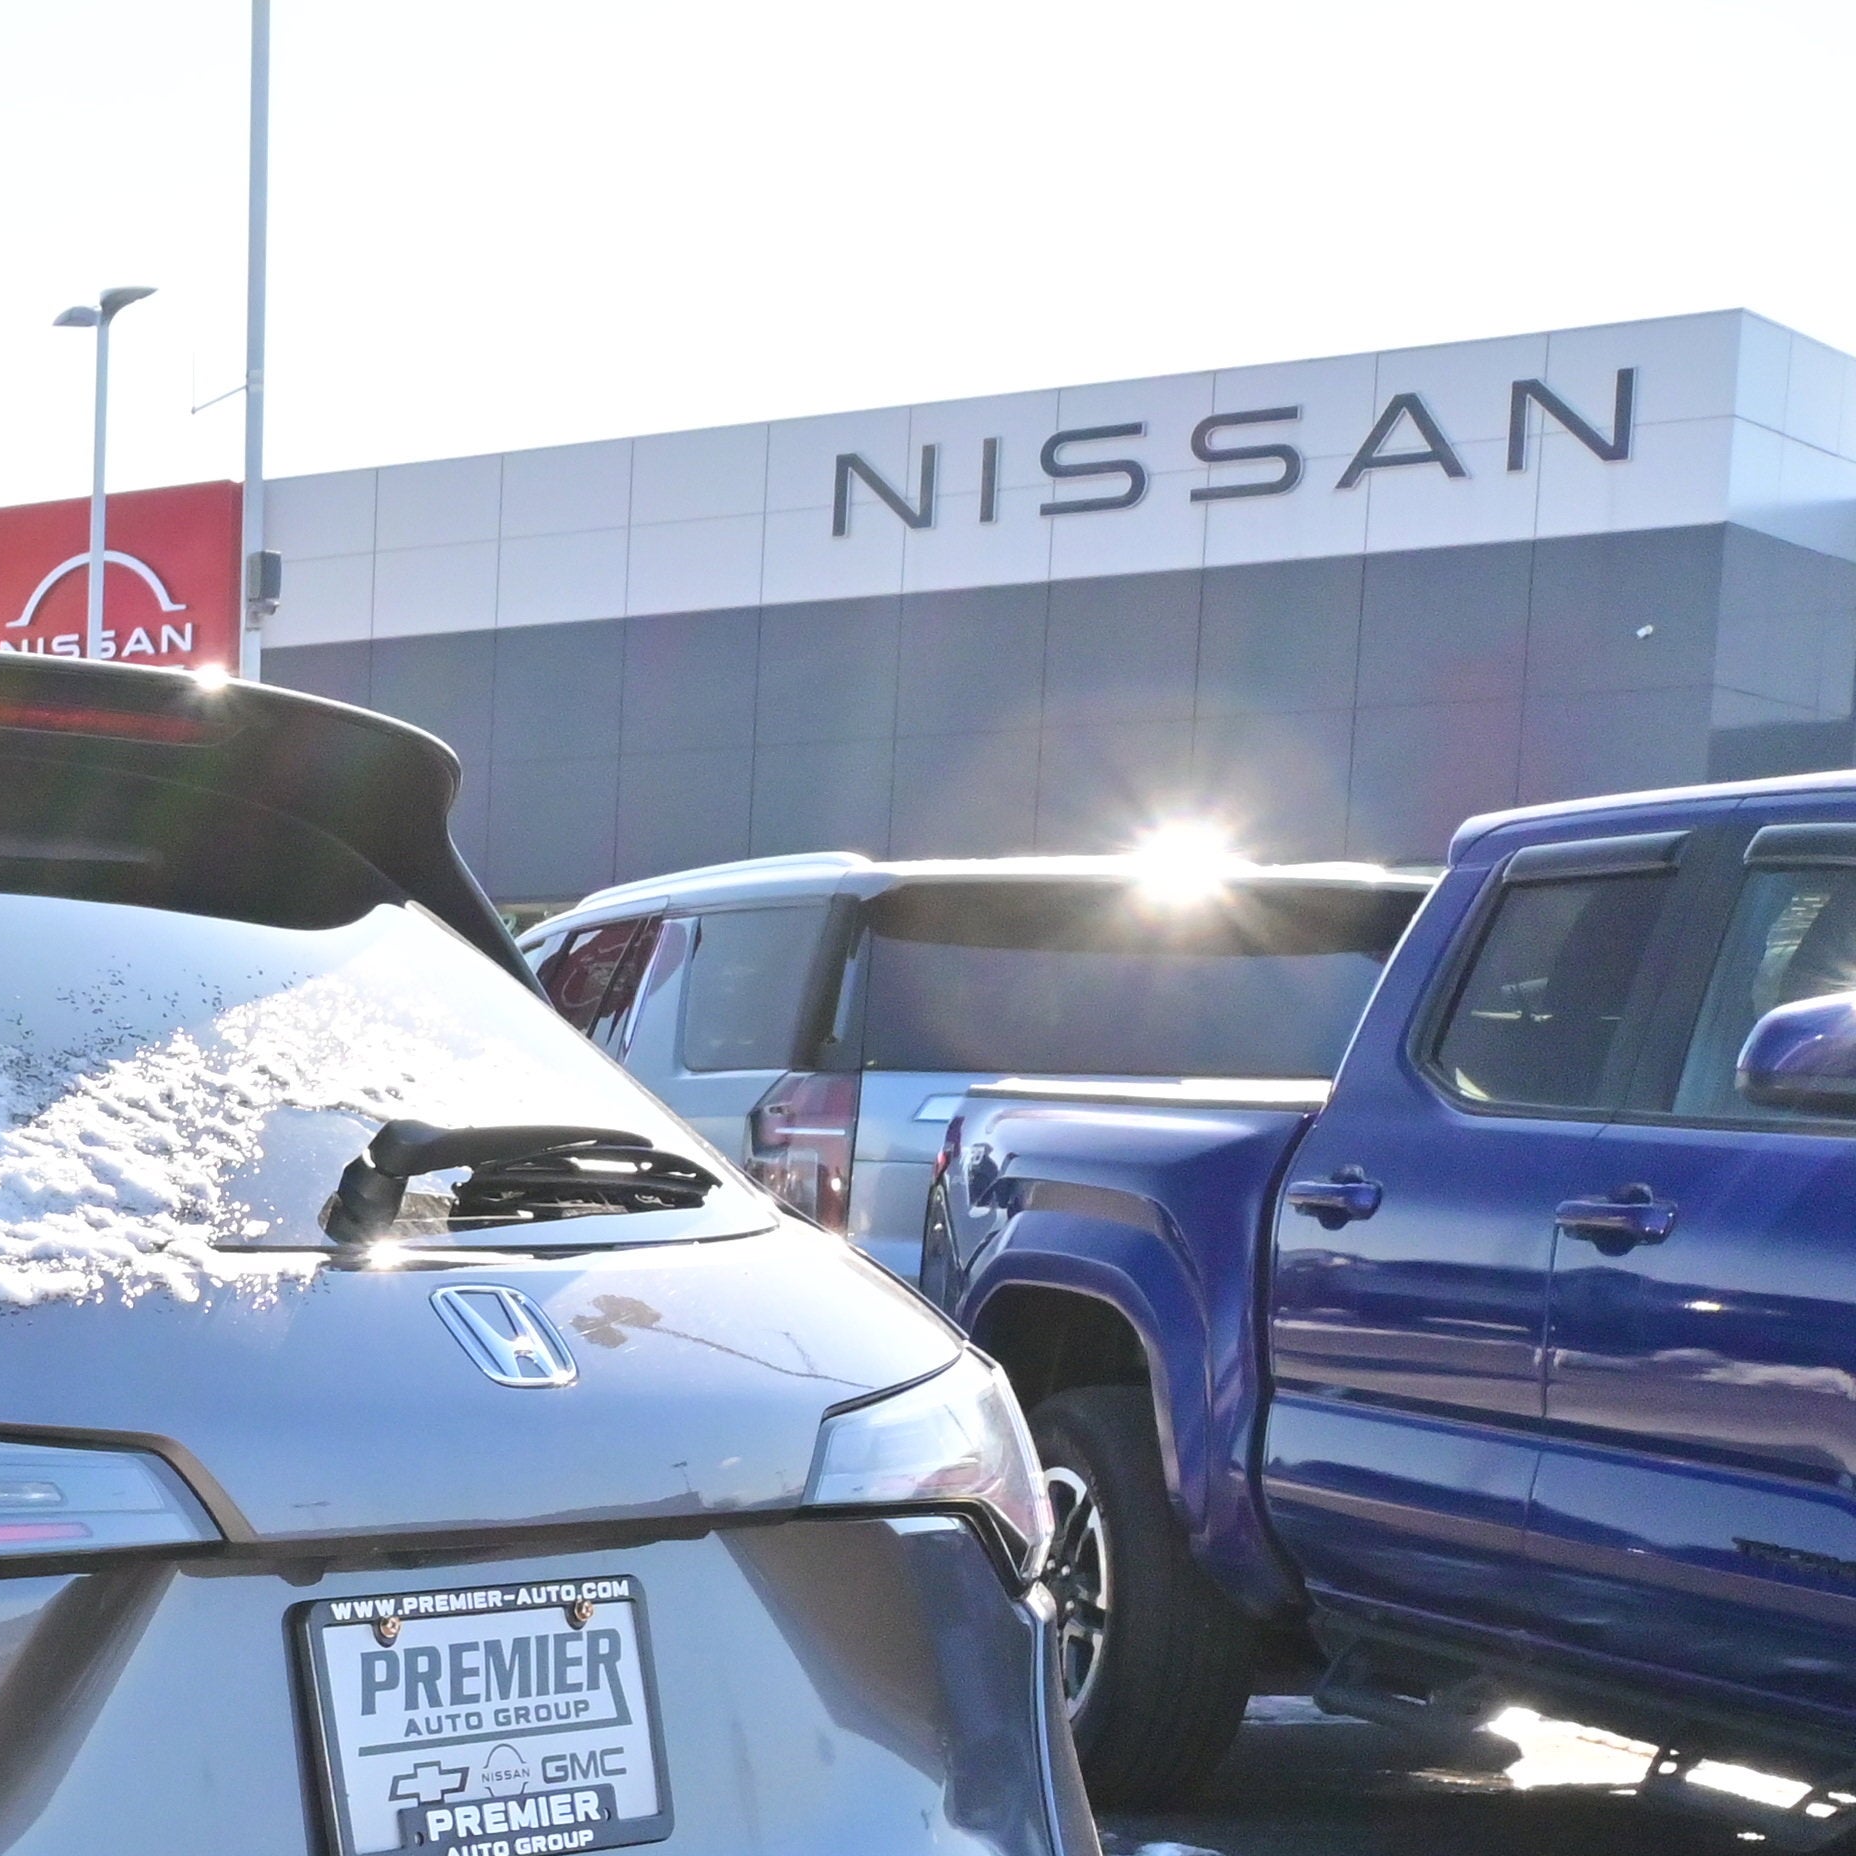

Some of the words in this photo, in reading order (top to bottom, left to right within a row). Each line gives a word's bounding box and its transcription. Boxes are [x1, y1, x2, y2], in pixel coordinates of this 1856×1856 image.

[831, 366, 1636, 537] NISSAN
[331, 1580, 630, 1621] WWW.PREMIER-AUTO.COM
[360, 1627, 630, 1719] PREMIER
[403, 1708, 484, 1738] AUTO
[494, 1698, 591, 1727] GROUP
[481, 1765, 531, 1784] NISSAN
[541, 1746, 628, 1784] GMC
[425, 1790, 601, 1842] PREMIER
[514, 1829, 594, 1856] GROUP
